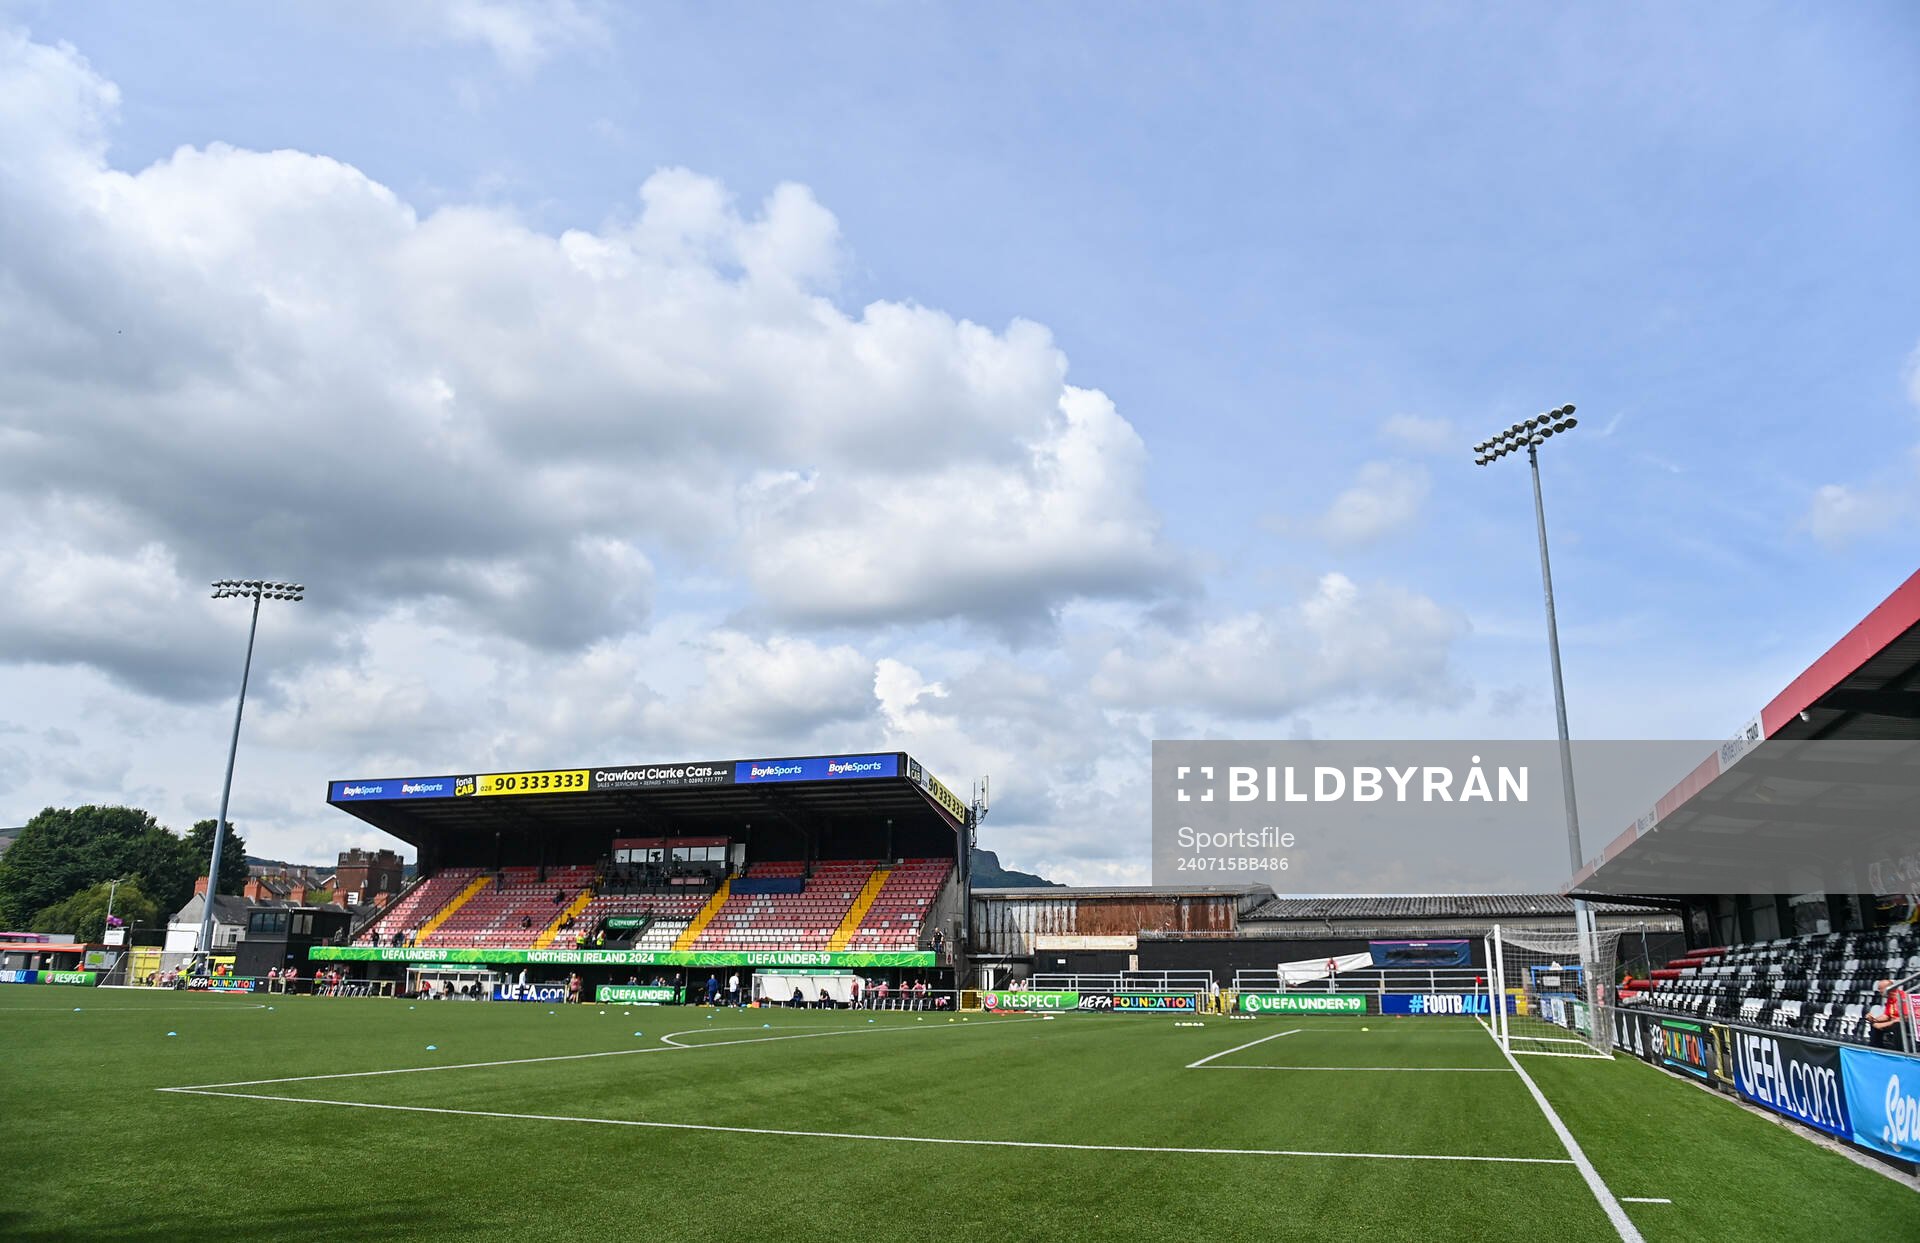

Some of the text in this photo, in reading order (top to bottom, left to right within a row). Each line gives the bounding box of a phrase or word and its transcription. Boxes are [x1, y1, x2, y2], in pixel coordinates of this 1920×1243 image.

[751, 765, 802, 777] BoyleSports
[829, 761, 882, 773] BoyleSports
[595, 769, 645, 782] Crawford
[647, 768, 684, 779] Clarke
[686, 766, 712, 777] Cars
[456, 777, 473, 787] fona
[495, 777, 516, 790] 90
[520, 776, 550, 790] 333
[553, 774, 584, 788] 333
[343, 786, 382, 796] BoyleSports
[402, 783, 442, 794] BoyleSports
[455, 784, 475, 796] CAB
[382, 950, 448, 960] UEFA UNDER-19
[527, 952, 655, 963] NORTHERN IRELAND 2024
[747, 953, 831, 965] UEFA UNDER-19
[54, 973, 87, 984] RESPECT
[611, 988, 636, 999] UEFA
[1003, 994, 1062, 1008] RESPECT
[1079, 995, 1113, 1007] UEFA
[1262, 998, 1360, 1010] UEFA UNDER-19
[1408, 994, 1489, 1014] #FOOTBALL
[1735, 1031, 1846, 1131] UEFA.com
